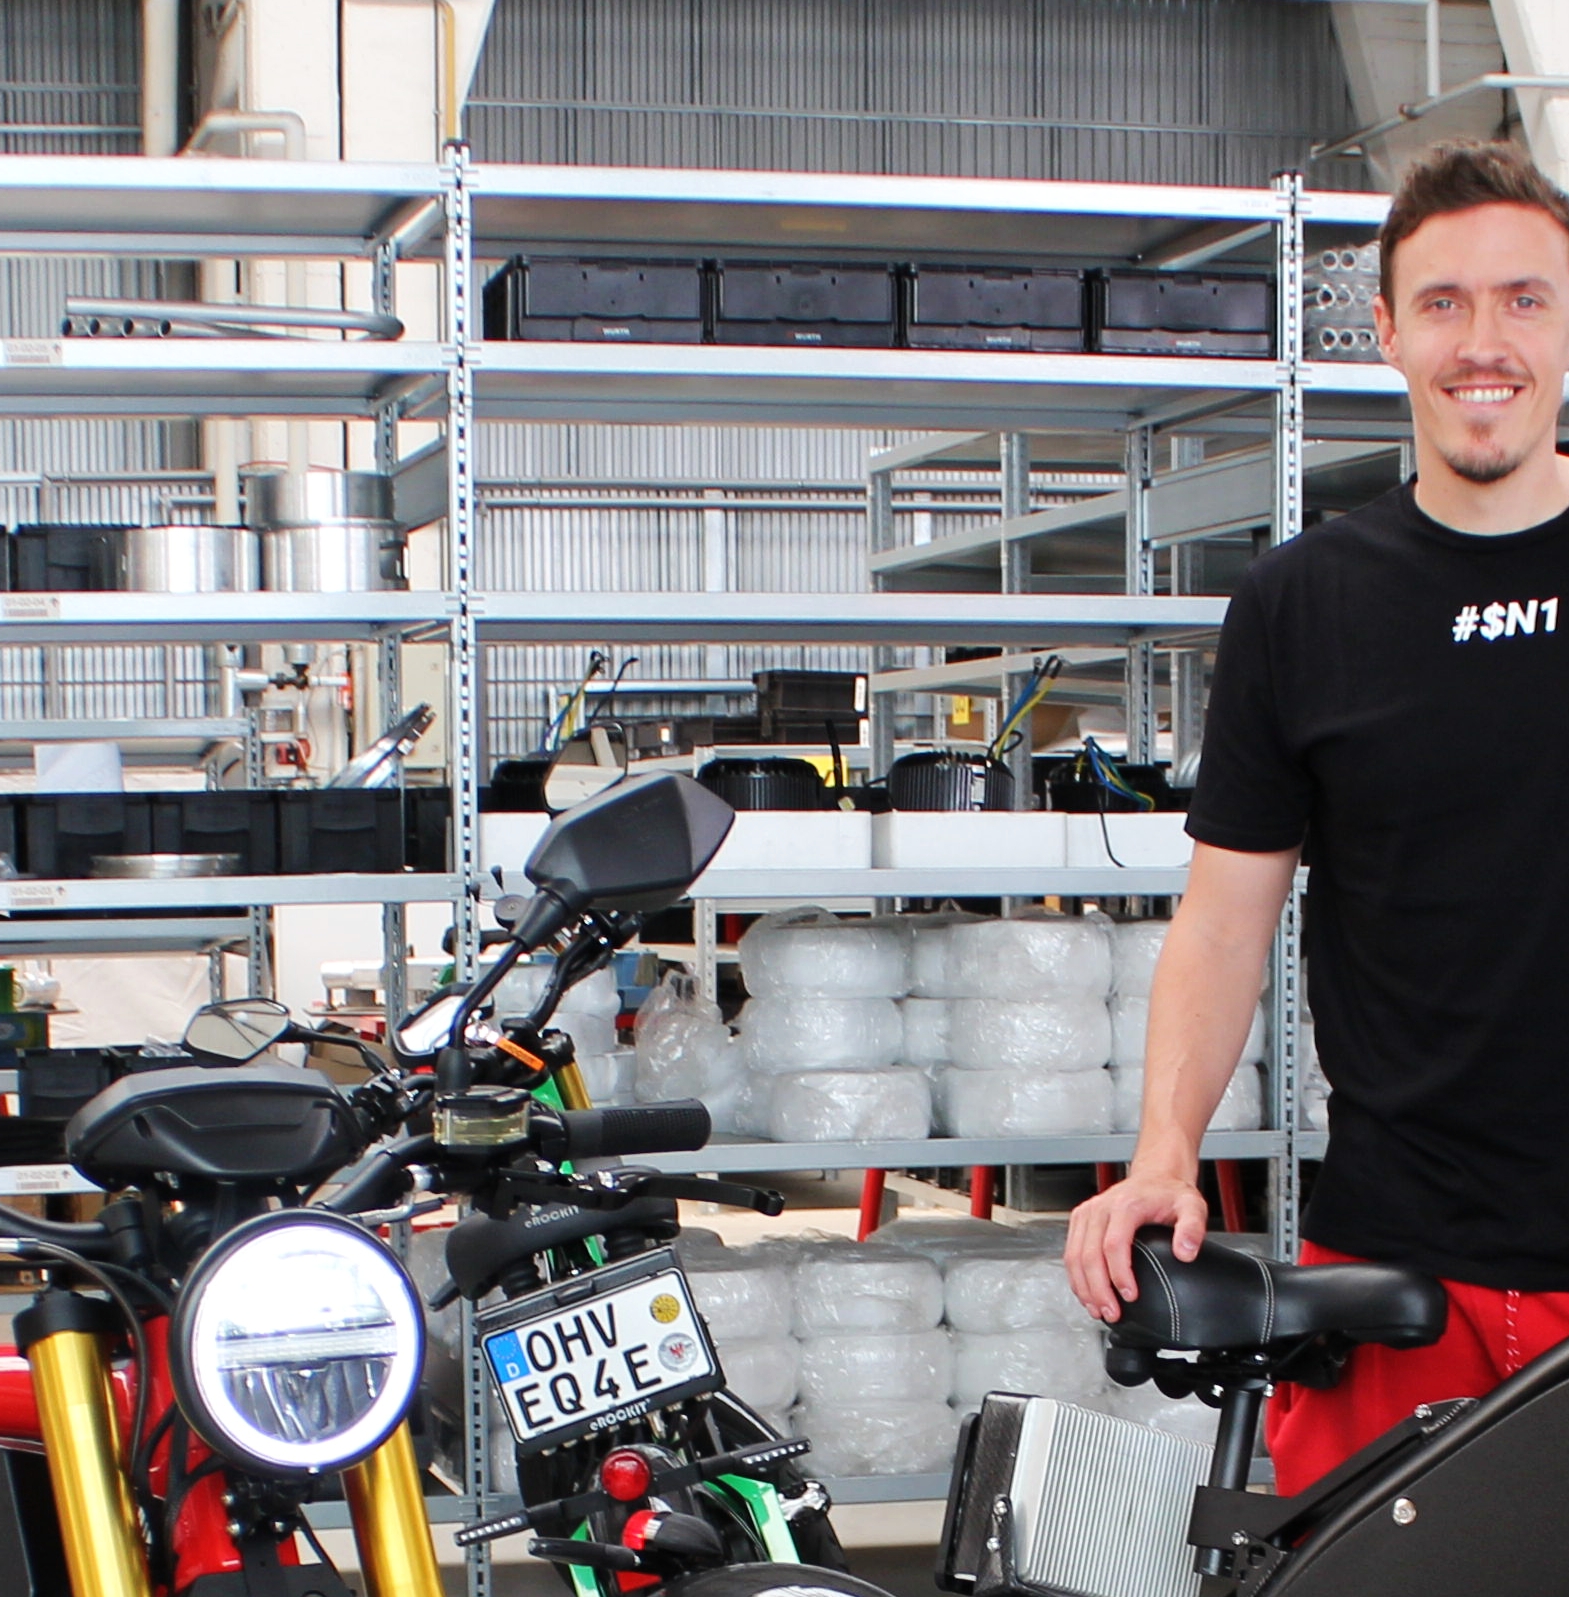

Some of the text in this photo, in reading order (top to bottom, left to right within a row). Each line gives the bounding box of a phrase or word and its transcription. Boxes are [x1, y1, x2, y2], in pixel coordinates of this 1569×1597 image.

[1452, 597, 1559, 642] #$N1
[525, 1205, 580, 1229] eROCKIT
[526, 1302, 618, 1373] OHV
[505, 1361, 521, 1379] D
[589, 1402, 649, 1431] eROCKIT
